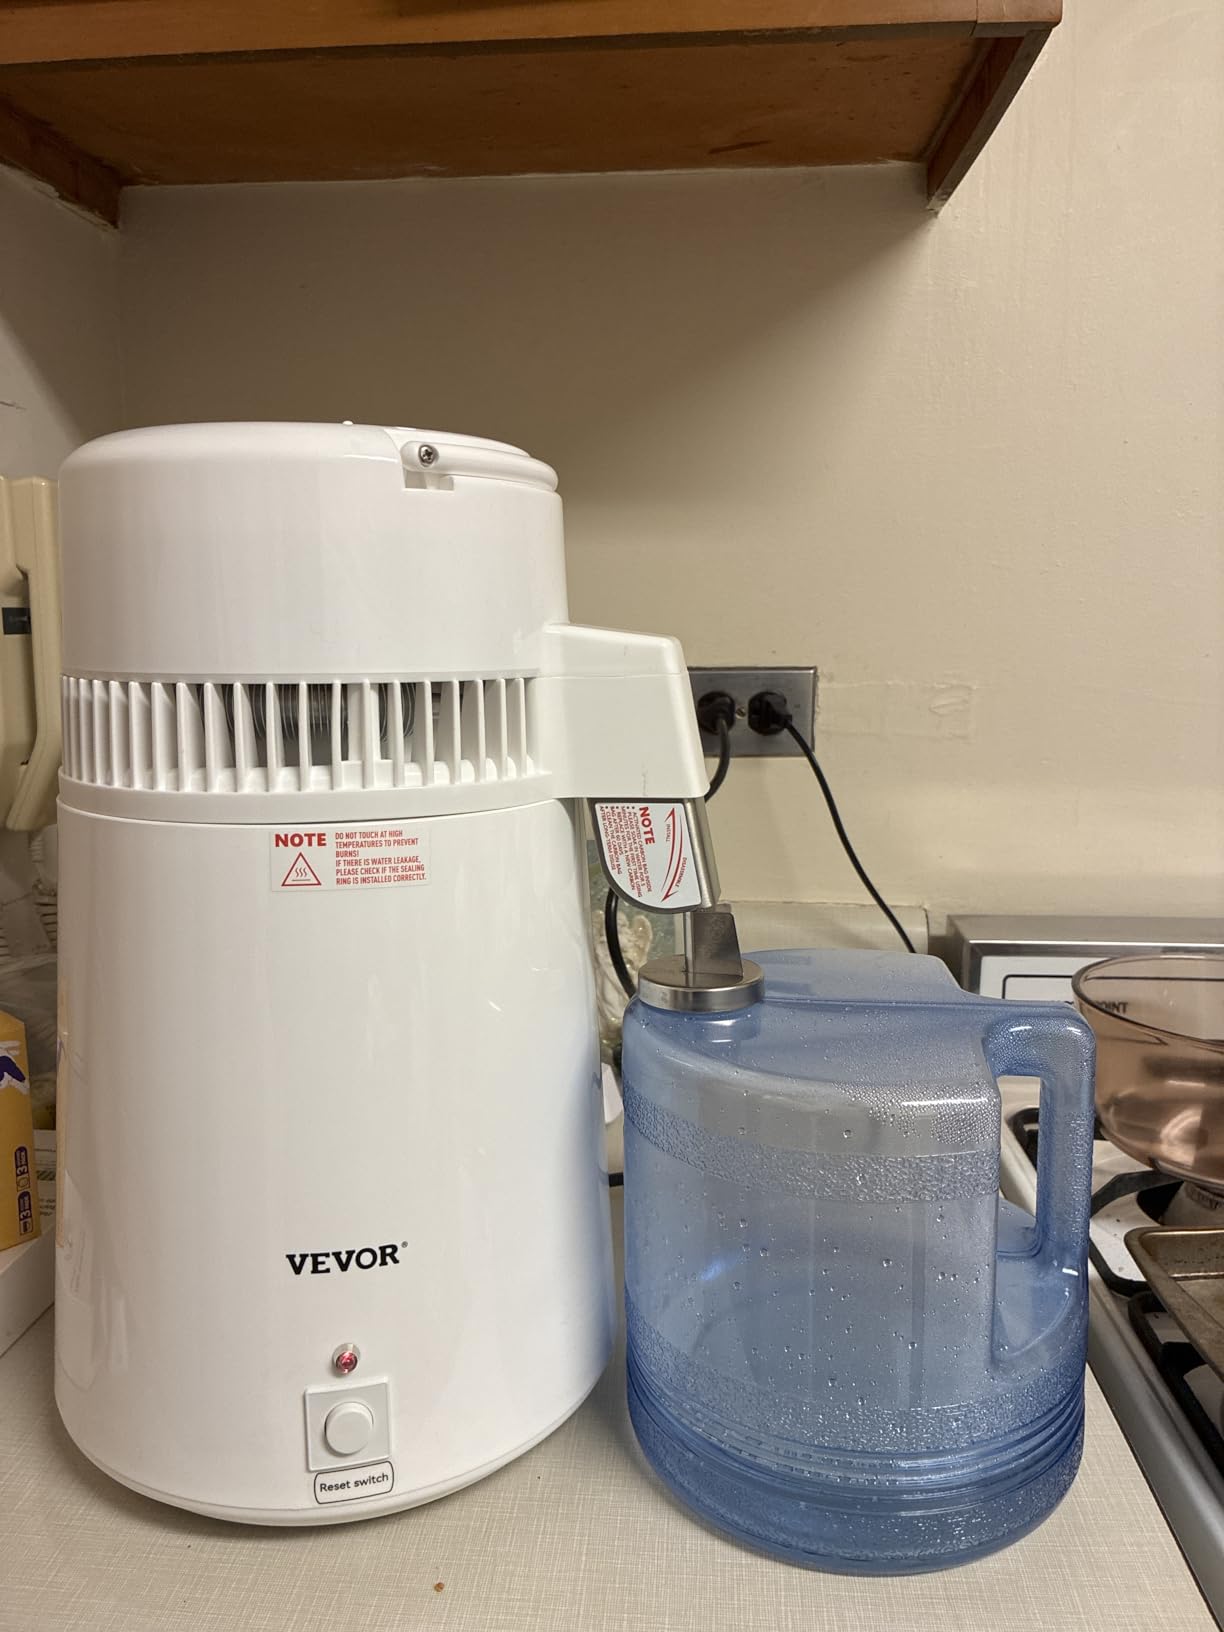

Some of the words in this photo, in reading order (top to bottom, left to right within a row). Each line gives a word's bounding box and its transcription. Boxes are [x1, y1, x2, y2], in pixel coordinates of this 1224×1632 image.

[633, 812, 641, 839] ACTIVATED
[639, 807, 654, 844] NOTE
[275, 833, 327, 848] NOTE
[359, 831, 378, 839] TOUCH
[335, 840, 383, 848] TEMPERATURES
[393, 838, 418, 846] PREVENT
[343, 859, 362, 867] THERE
[371, 857, 392, 865] WATER
[394, 856, 421, 864] LEAKAGE,
[336, 868, 358, 876] PLEASE
[401, 864, 424, 873] SEALING
[675, 857, 687, 887] DISASSEMBLE
[360, 875, 391, 884] INSTALLED
[393, 873, 426, 882] CORRECTLY.
[320, 1480, 351, 1492] Reset
[354, 1473, 389, 1488] switch
